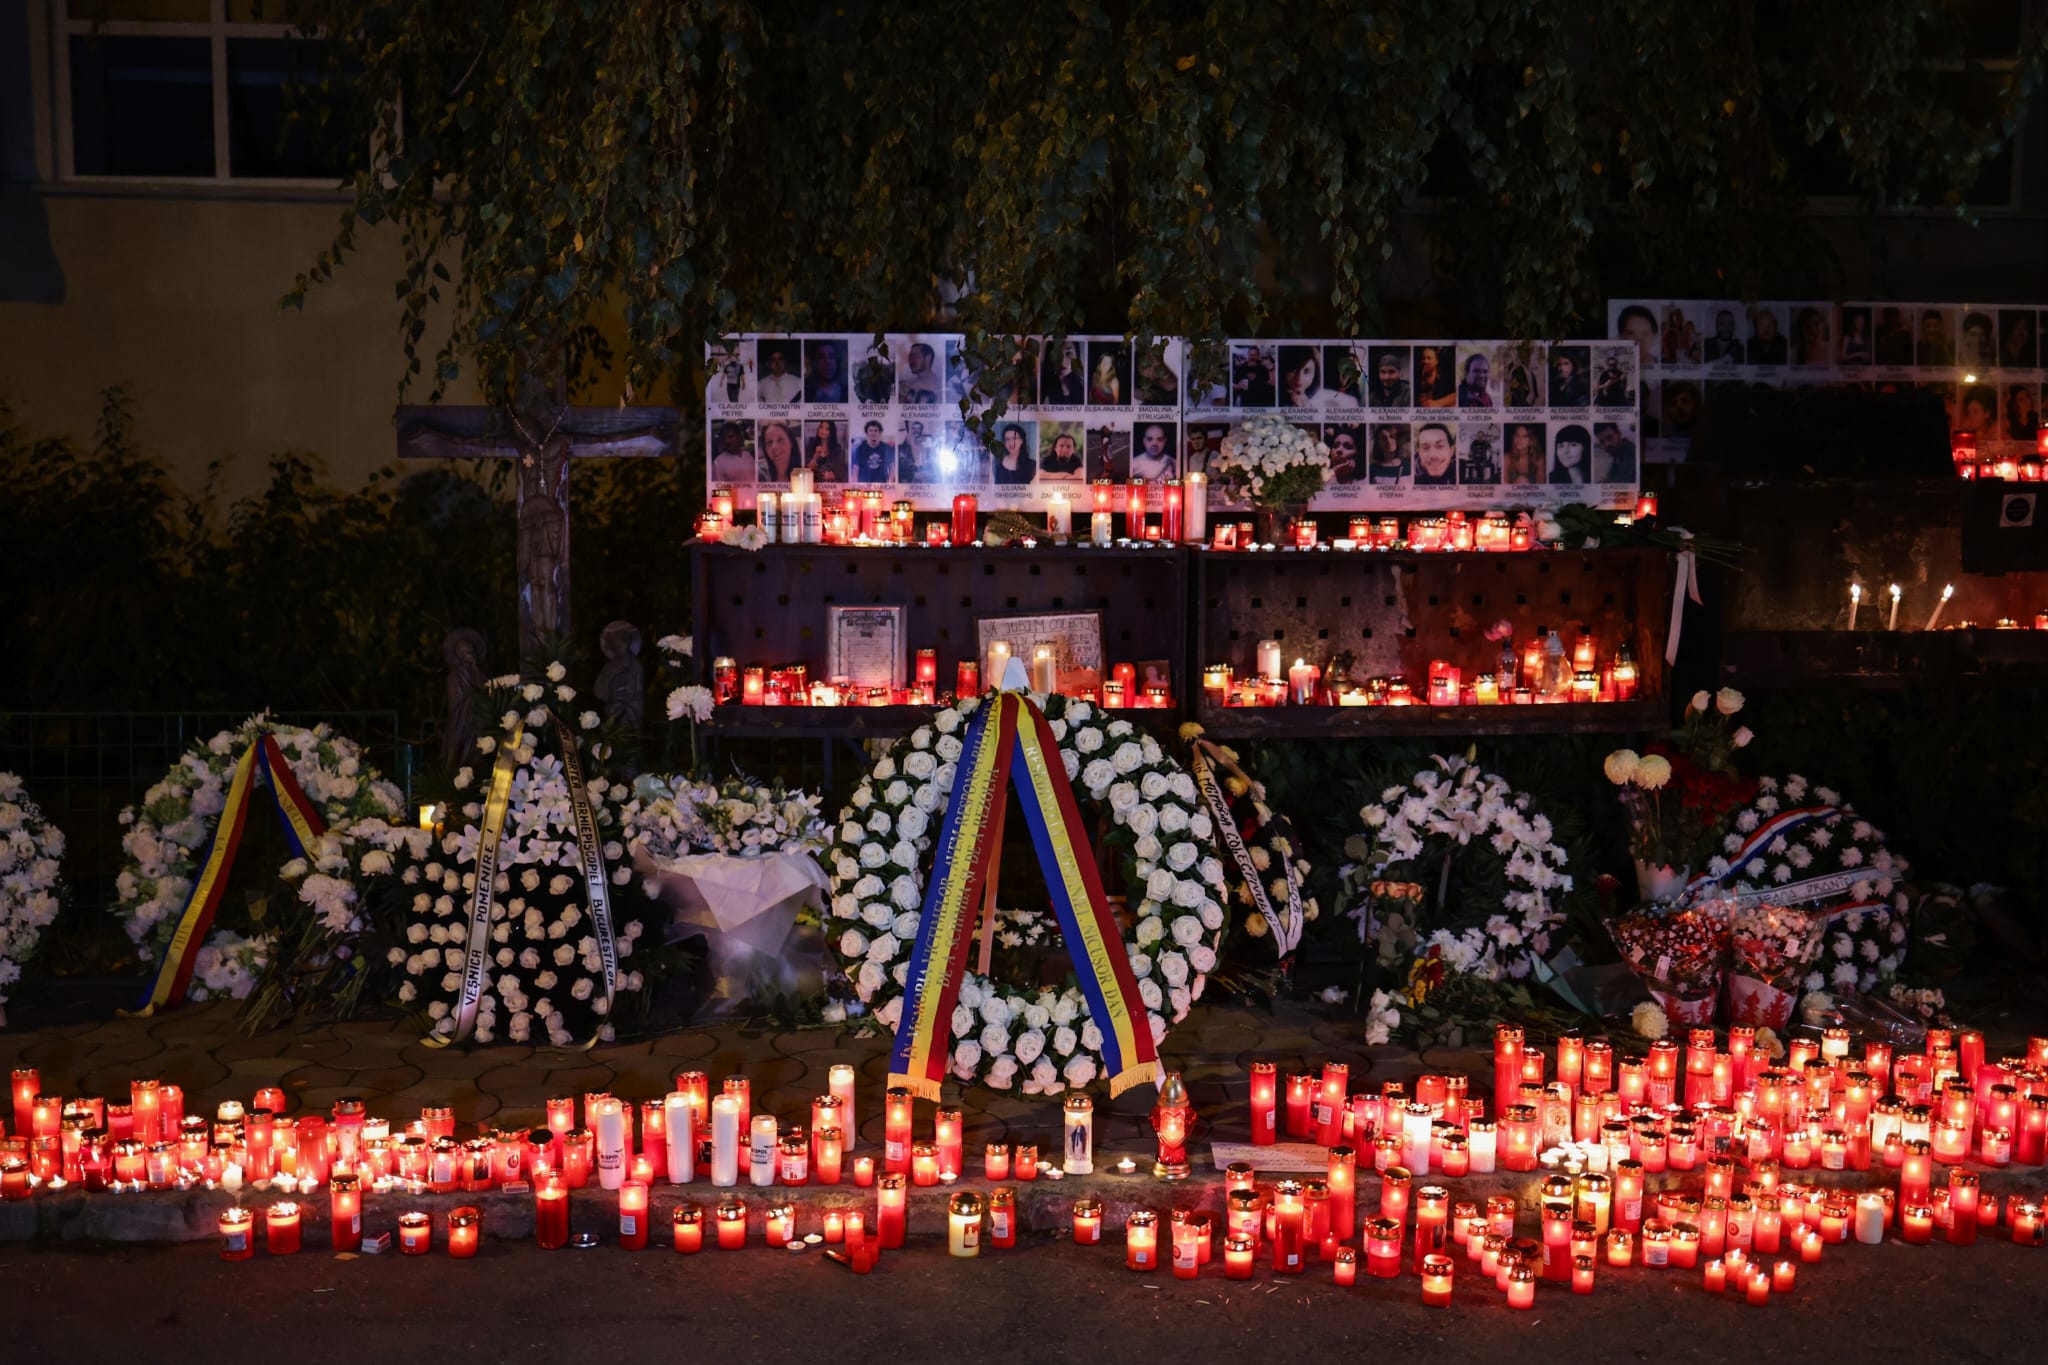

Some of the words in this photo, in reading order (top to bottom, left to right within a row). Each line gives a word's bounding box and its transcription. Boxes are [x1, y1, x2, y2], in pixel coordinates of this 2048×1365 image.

[718, 402, 748, 410] CLAUDIU
[757, 402, 802, 410] CONSTANTIN
[812, 403, 840, 411] COSTEL
[857, 403, 889, 411] CRISTIAN
[1042, 405, 1065, 413] ELENA
[721, 410, 744, 418] PETRE
[769, 410, 790, 418] IGNAT
[807, 410, 846, 418] CARLICEAN
[861, 410, 886, 418] MITROI
[900, 411, 941, 419] ALEXANDRU
[1136, 413, 1175, 421] STRUGARU
[1409, 414, 1437, 422] CATALIN
[1001, 484, 1028, 492] LILIANA
[1051, 484, 1071, 493] LIVIU
[994, 491, 1034, 500] GHEORGHE
[566, 749, 582, 789] PARTEA
[978, 765, 1000, 828] REZOLVA
[969, 830, 985, 843] A
[964, 844, 982, 864] DE
[946, 884, 973, 950] SCHIMBA
[910, 967, 931, 1038] MEMORIA
[946, 829, 964, 869] AVEM
[940, 953, 955, 965] A
[935, 966, 953, 988] DE
[1103, 987, 1126, 1019] DAN
